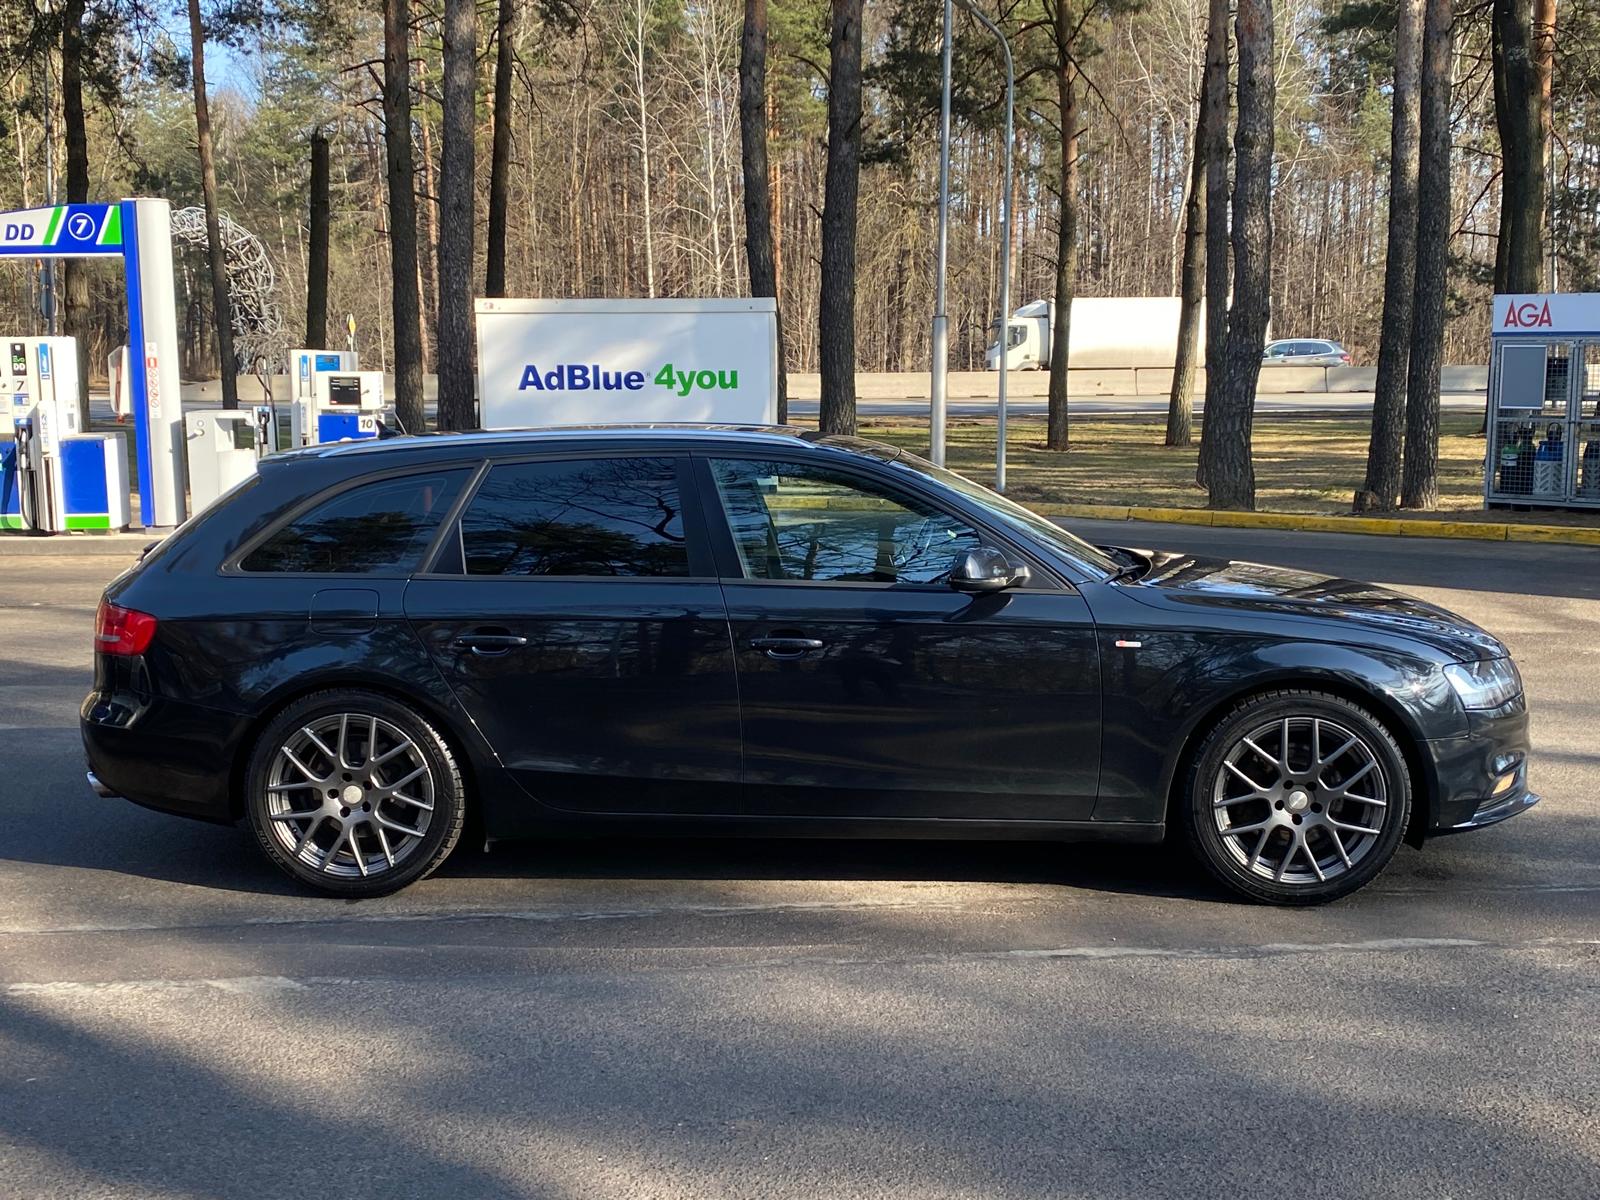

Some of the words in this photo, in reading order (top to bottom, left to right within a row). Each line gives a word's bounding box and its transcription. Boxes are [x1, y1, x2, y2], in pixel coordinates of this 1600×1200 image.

[5, 223, 35, 241] DD
[75, 218, 88, 235] 7
[1503, 297, 1553, 328] AGA
[16, 380, 25, 391] 7
[518, 364, 645, 391] AdBlue
[654, 363, 738, 397] 4you
[360, 419, 373, 429] 10
